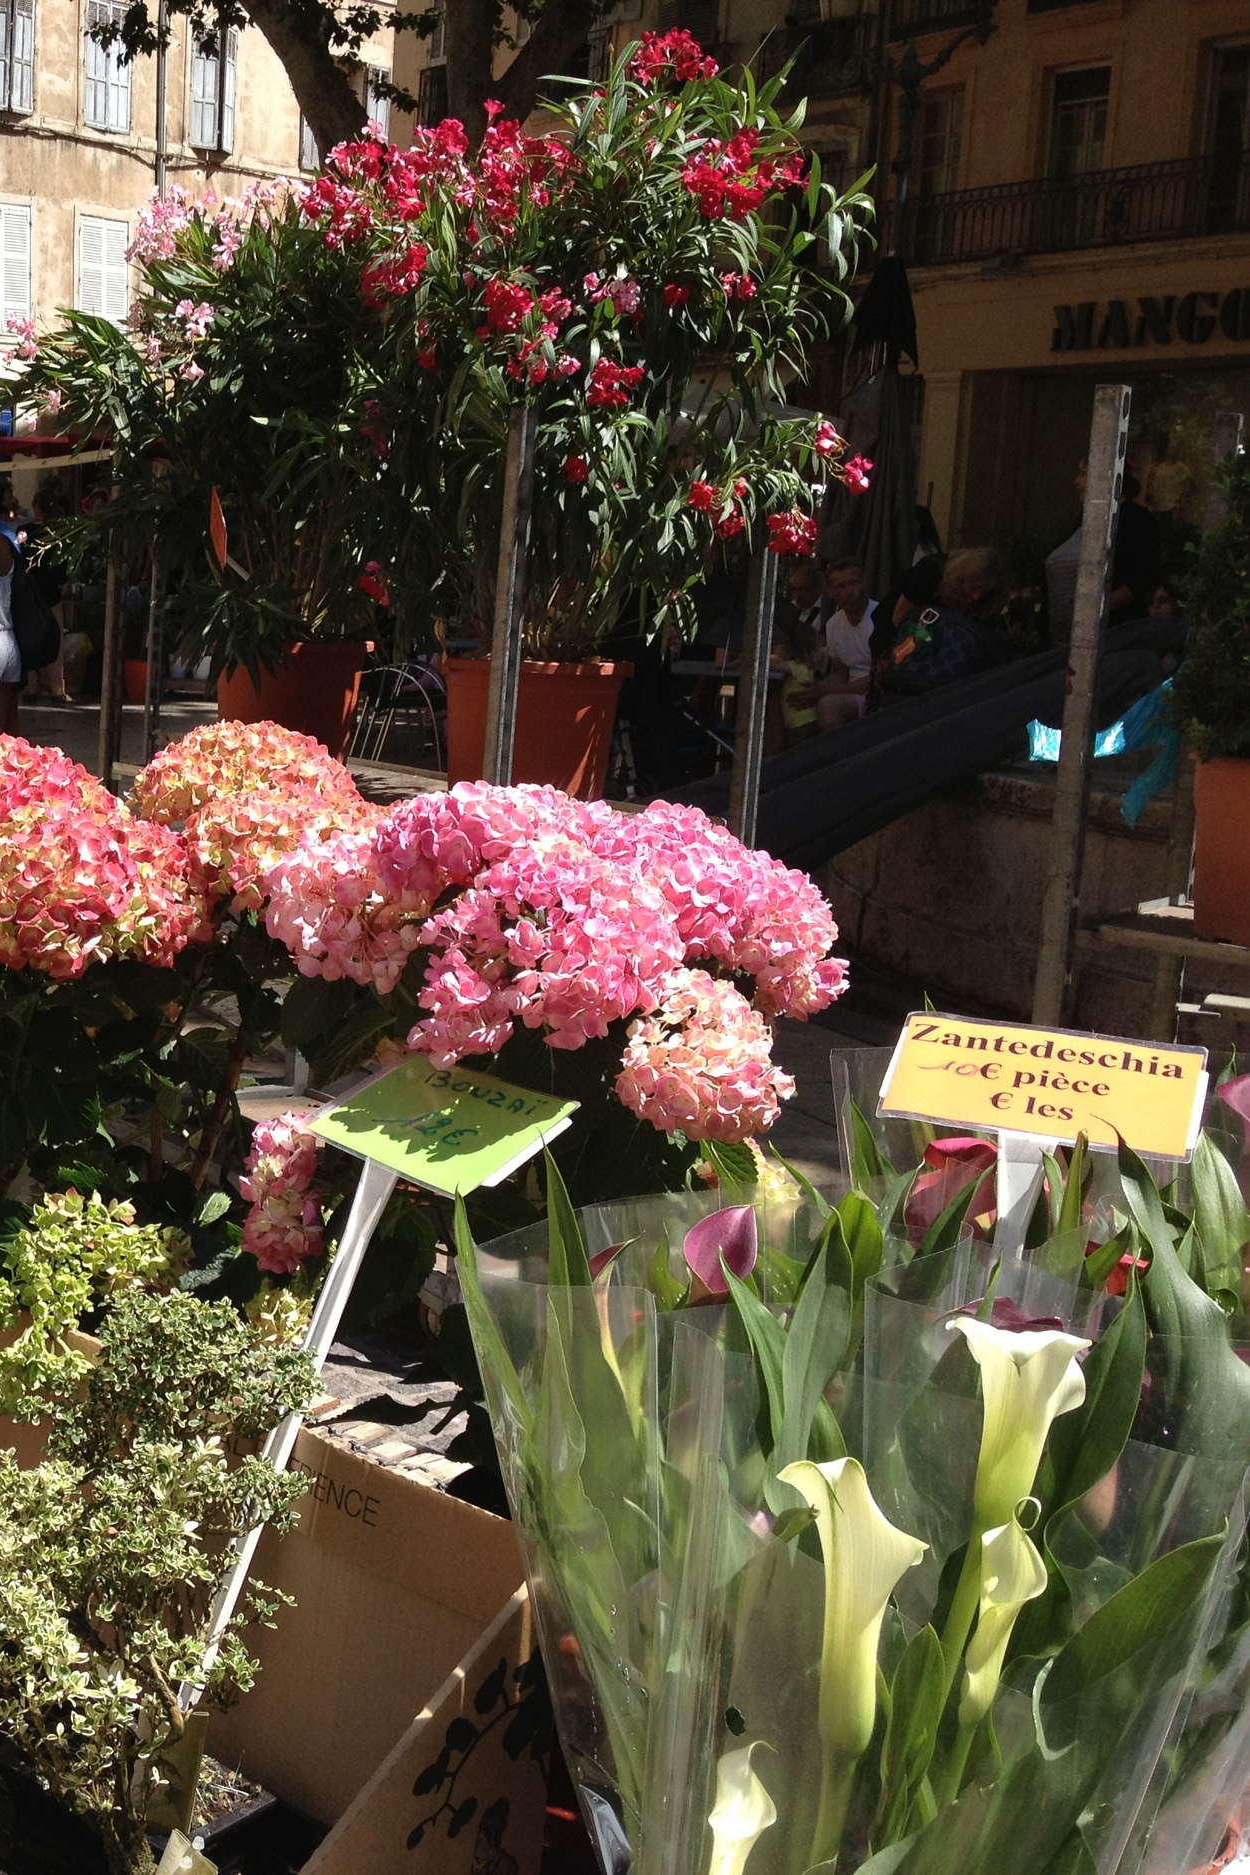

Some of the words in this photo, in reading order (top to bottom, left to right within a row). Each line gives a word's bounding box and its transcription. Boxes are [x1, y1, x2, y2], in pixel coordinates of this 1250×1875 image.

[1051, 287, 1250, 352] MANGO
[910, 1023, 1184, 1079] Zantedeschia
[1011, 1069, 1111, 1097] pièce
[989, 1091, 1014, 1111] €
[1024, 1095, 1075, 1121] les
